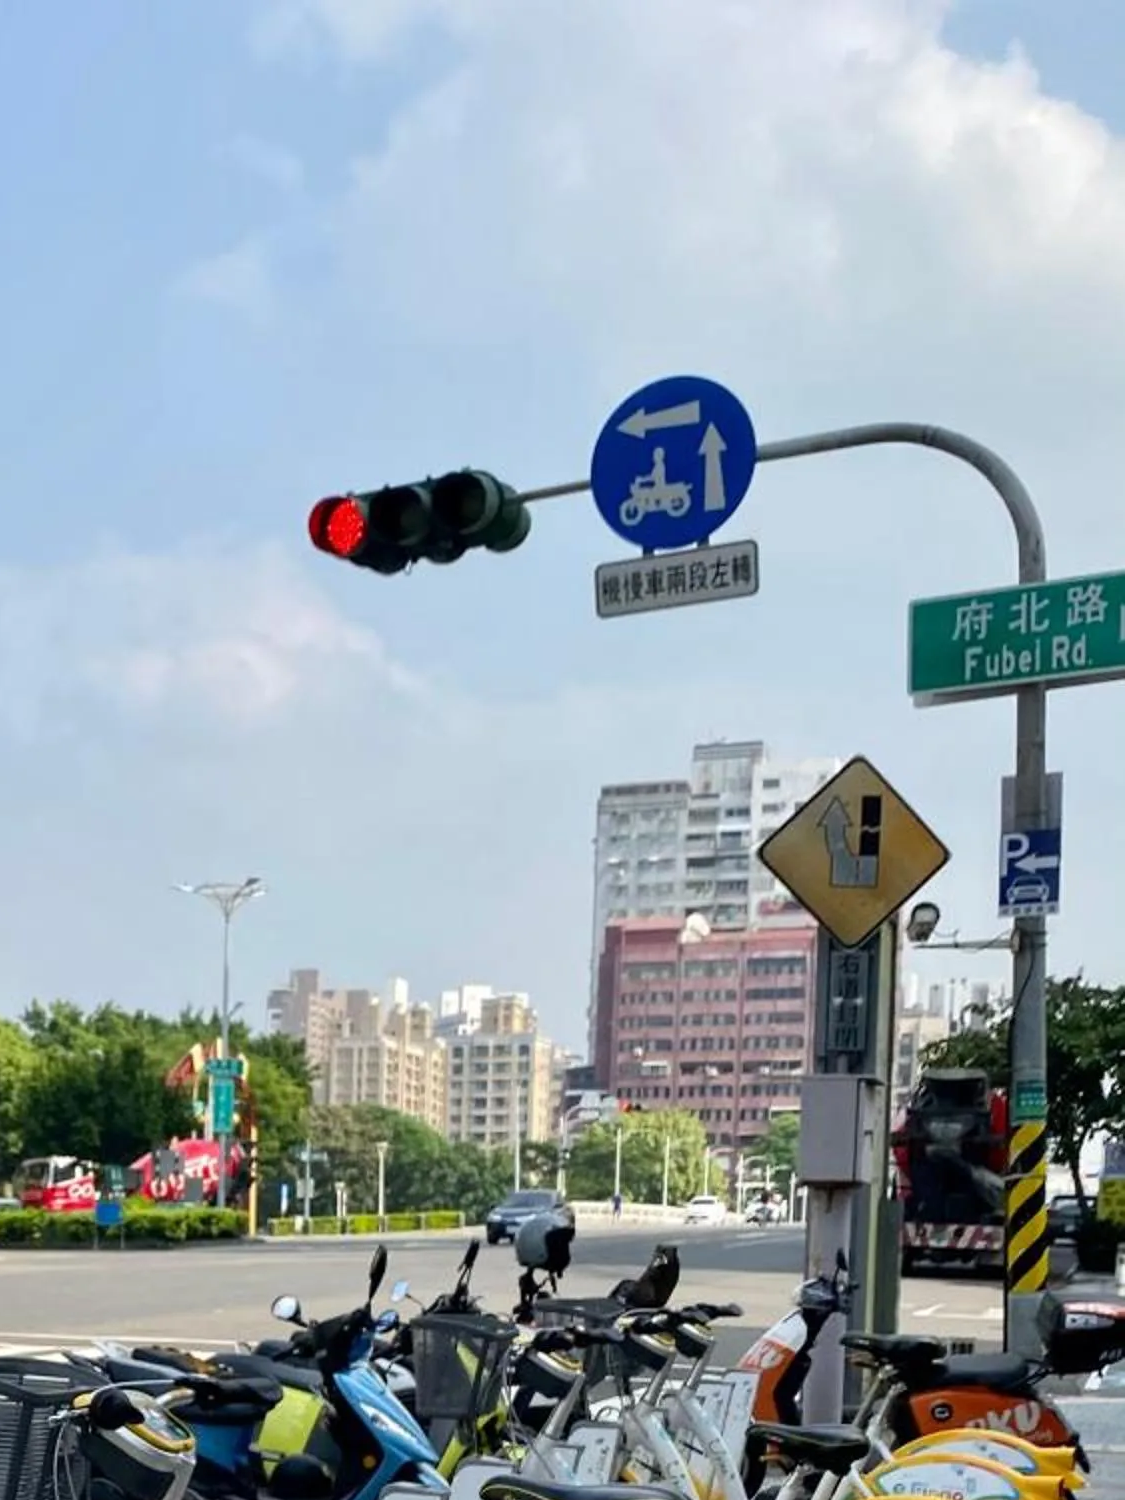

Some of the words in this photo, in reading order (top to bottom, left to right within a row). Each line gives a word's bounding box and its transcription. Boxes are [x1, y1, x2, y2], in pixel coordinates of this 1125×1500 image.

[951, 582, 1108, 642] 府北路
[964, 638, 1041, 681] Fubei
[1051, 633, 1093, 670] Rd.
[999, 832, 1030, 878] P
